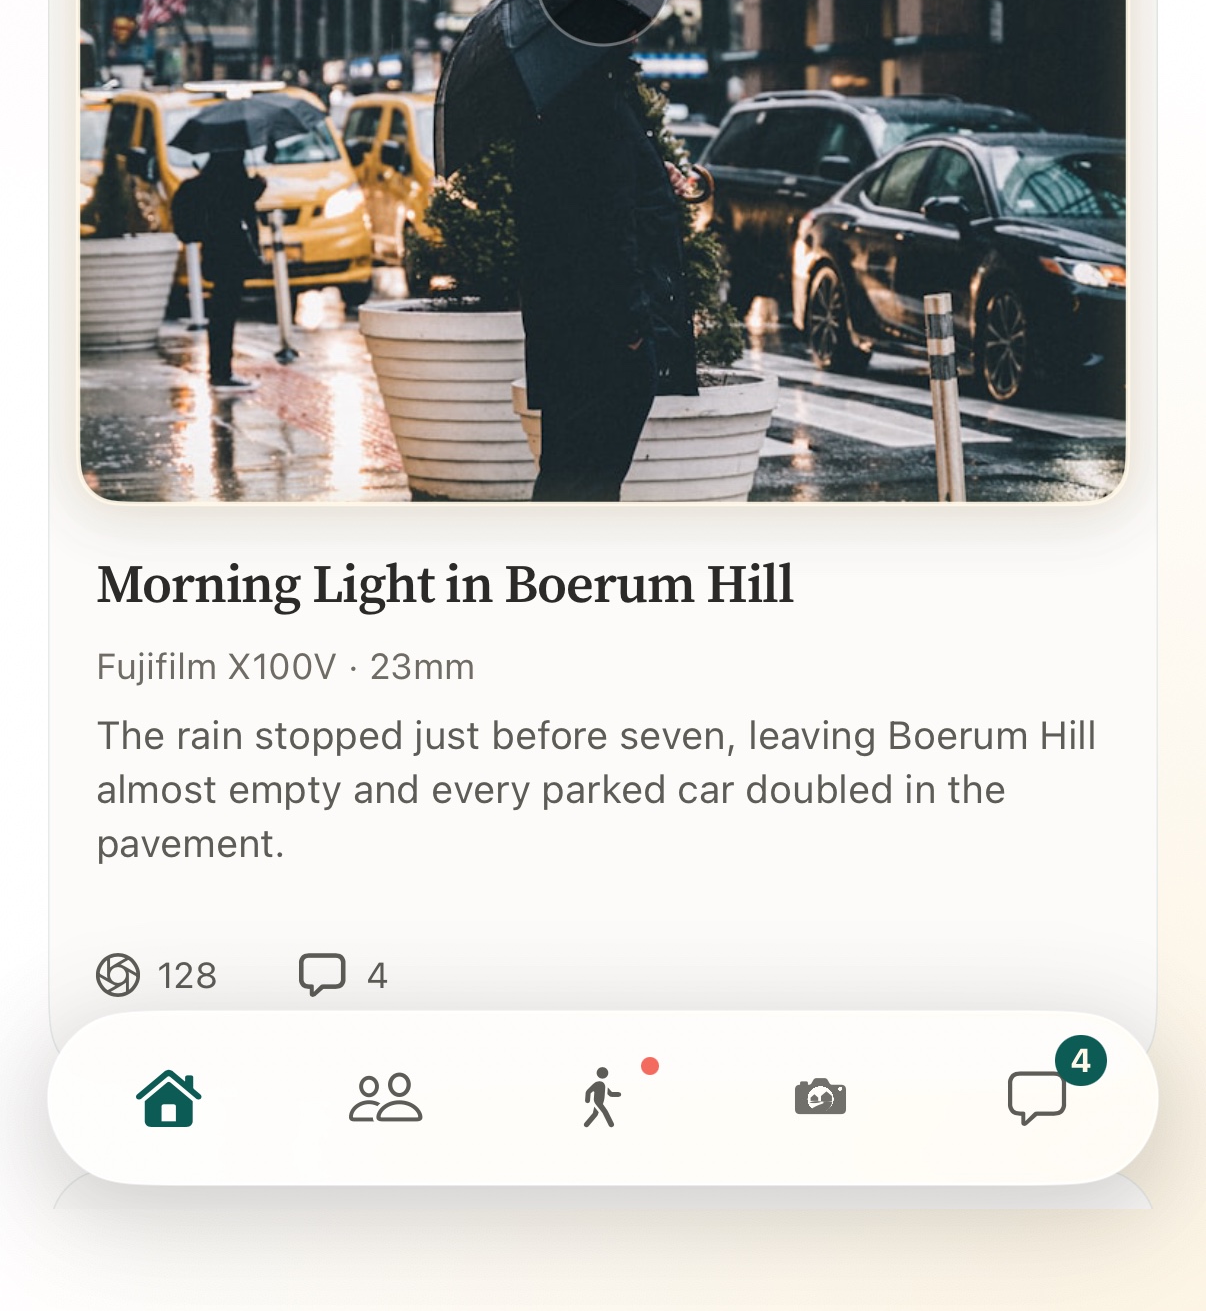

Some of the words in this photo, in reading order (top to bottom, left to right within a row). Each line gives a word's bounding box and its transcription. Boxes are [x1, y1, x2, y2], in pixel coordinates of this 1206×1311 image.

[97, 563, 301, 615] Morning
[314, 562, 435, 615] Light
[446, 563, 493, 602] in
[506, 566, 695, 603] Boerum
[708, 562, 794, 602] Hill
[99, 652, 215, 686] Fujifilm
[229, 653, 336, 680] X100V
[372, 653, 473, 680] 23mm
[98, 720, 163, 750] The
[179, 720, 241, 749] rain
[256, 720, 401, 756] stopped
[413, 720, 479, 756] just
[494, 720, 606, 750] before
[621, 728, 734, 756] seven,
[751, 720, 874, 756] leaving
[890, 721, 1026, 750] Boerum
[1042, 720, 1094, 749] Hill
[98, 774, 216, 804] almost
[230, 777, 341, 810] empty
[355, 774, 417, 804] and
[433, 782, 530, 810] every
[544, 774, 664, 810] parked
[679, 782, 734, 804] car
[747, 774, 891, 804] doubled
[907, 774, 934, 803] in
[948, 774, 1004, 804] the
[99, 831, 282, 864] pavement.
[159, 962, 216, 989] 128
[368, 962, 387, 988] 4
[1071, 1049, 1091, 1072] 4
